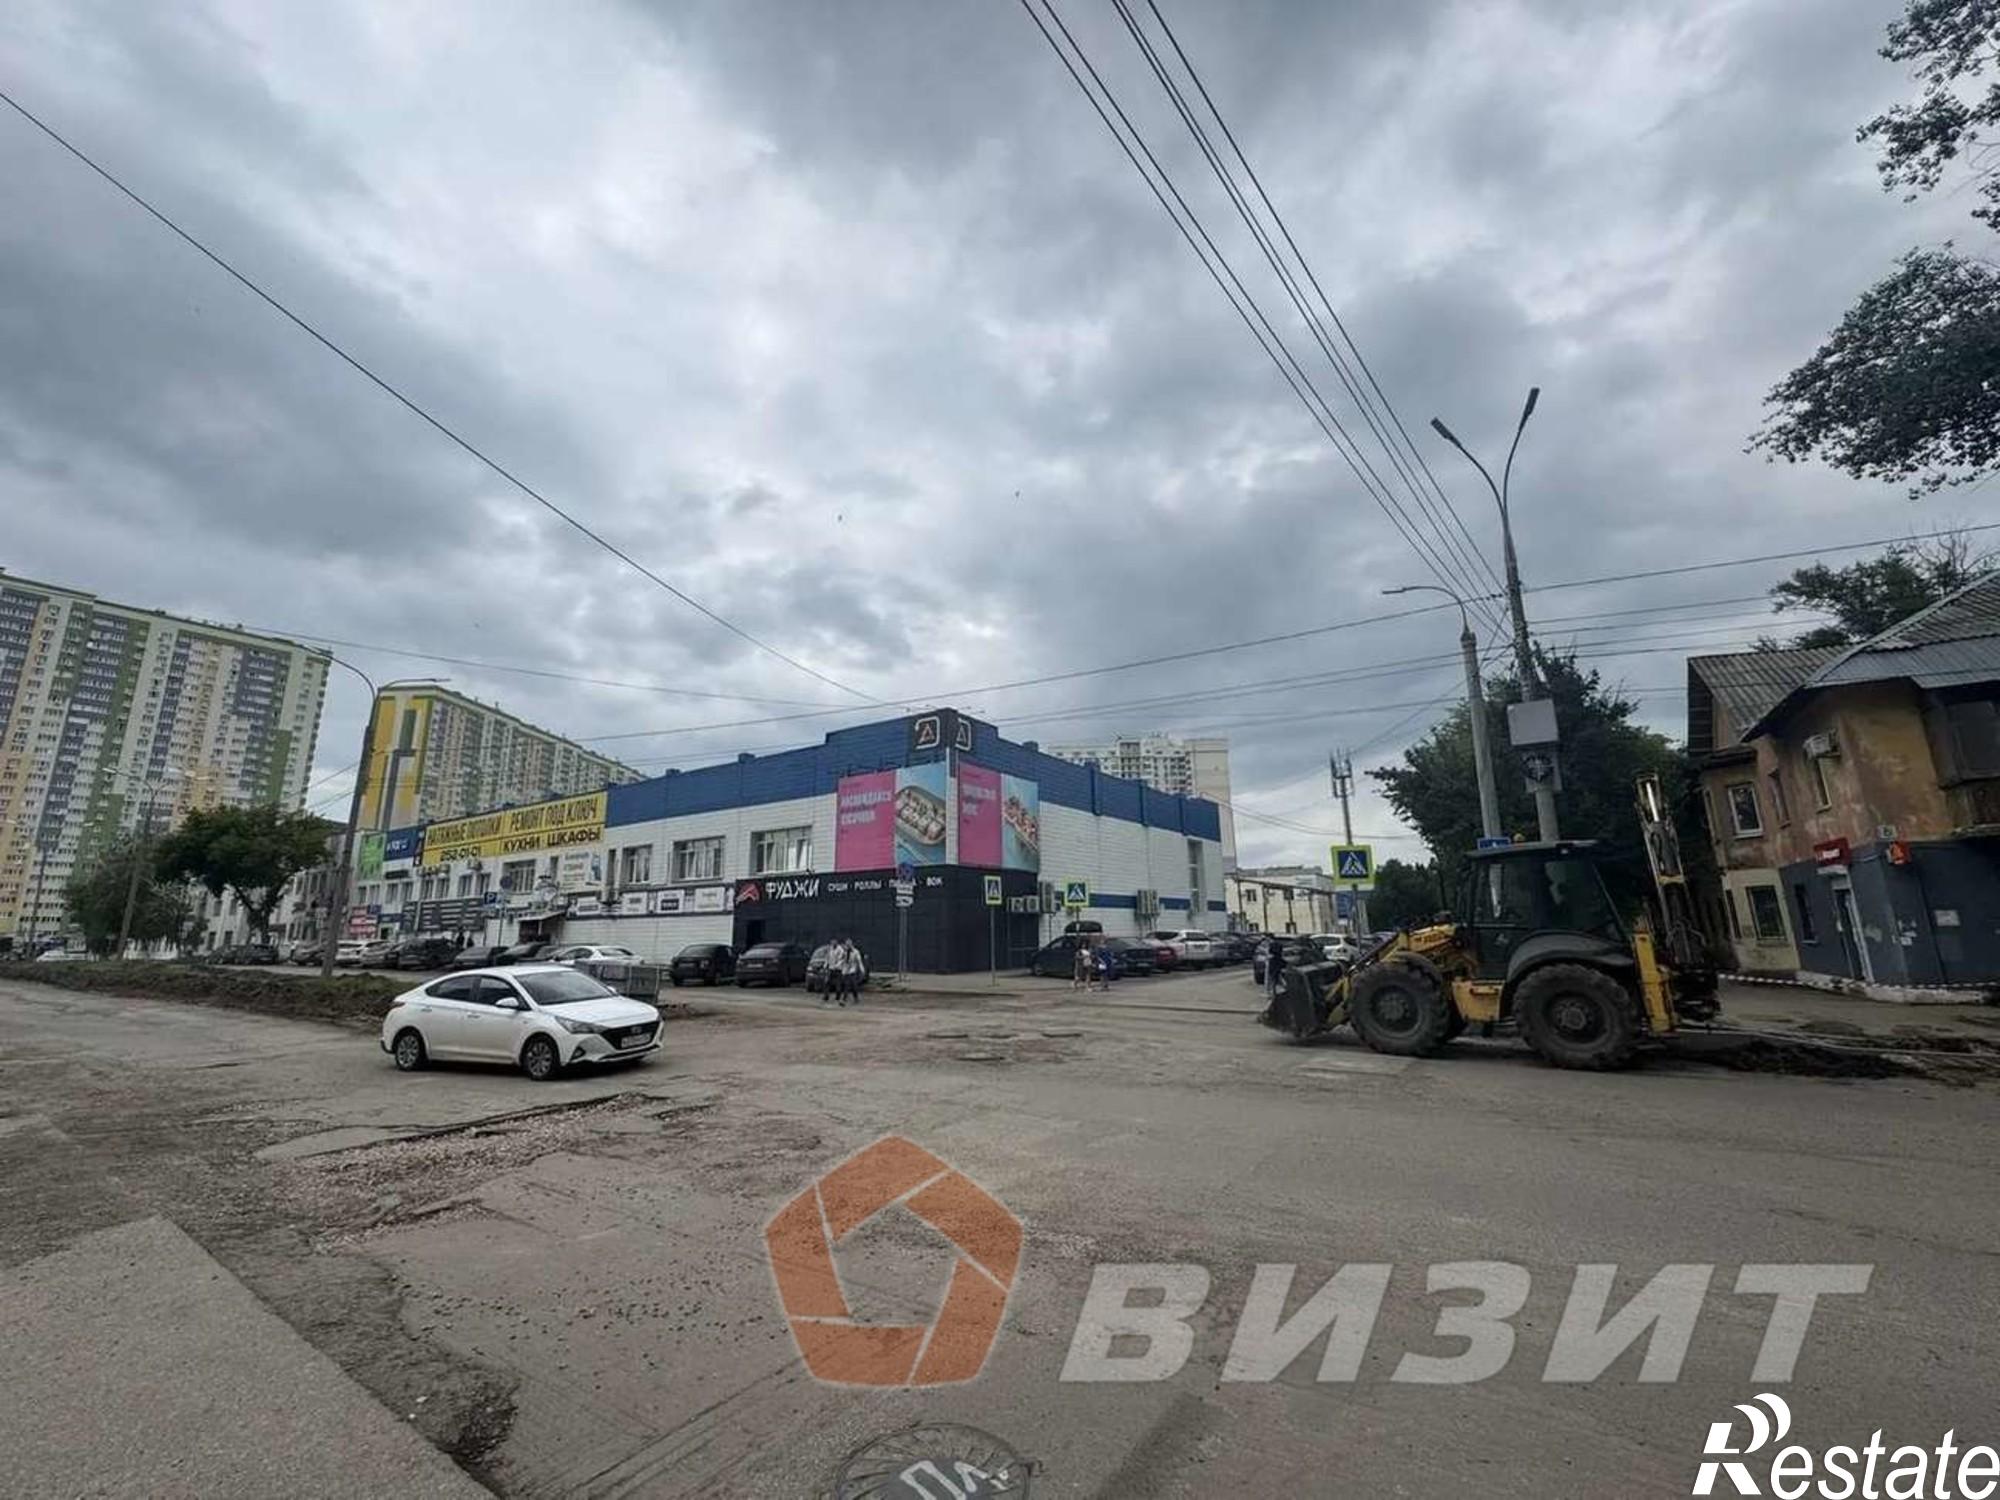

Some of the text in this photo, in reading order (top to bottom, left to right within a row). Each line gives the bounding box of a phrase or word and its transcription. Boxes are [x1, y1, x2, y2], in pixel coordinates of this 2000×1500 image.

[503, 826, 601, 853] КУХНИ ШКАФЫ
[765, 878, 820, 899] ФУДЖИ
